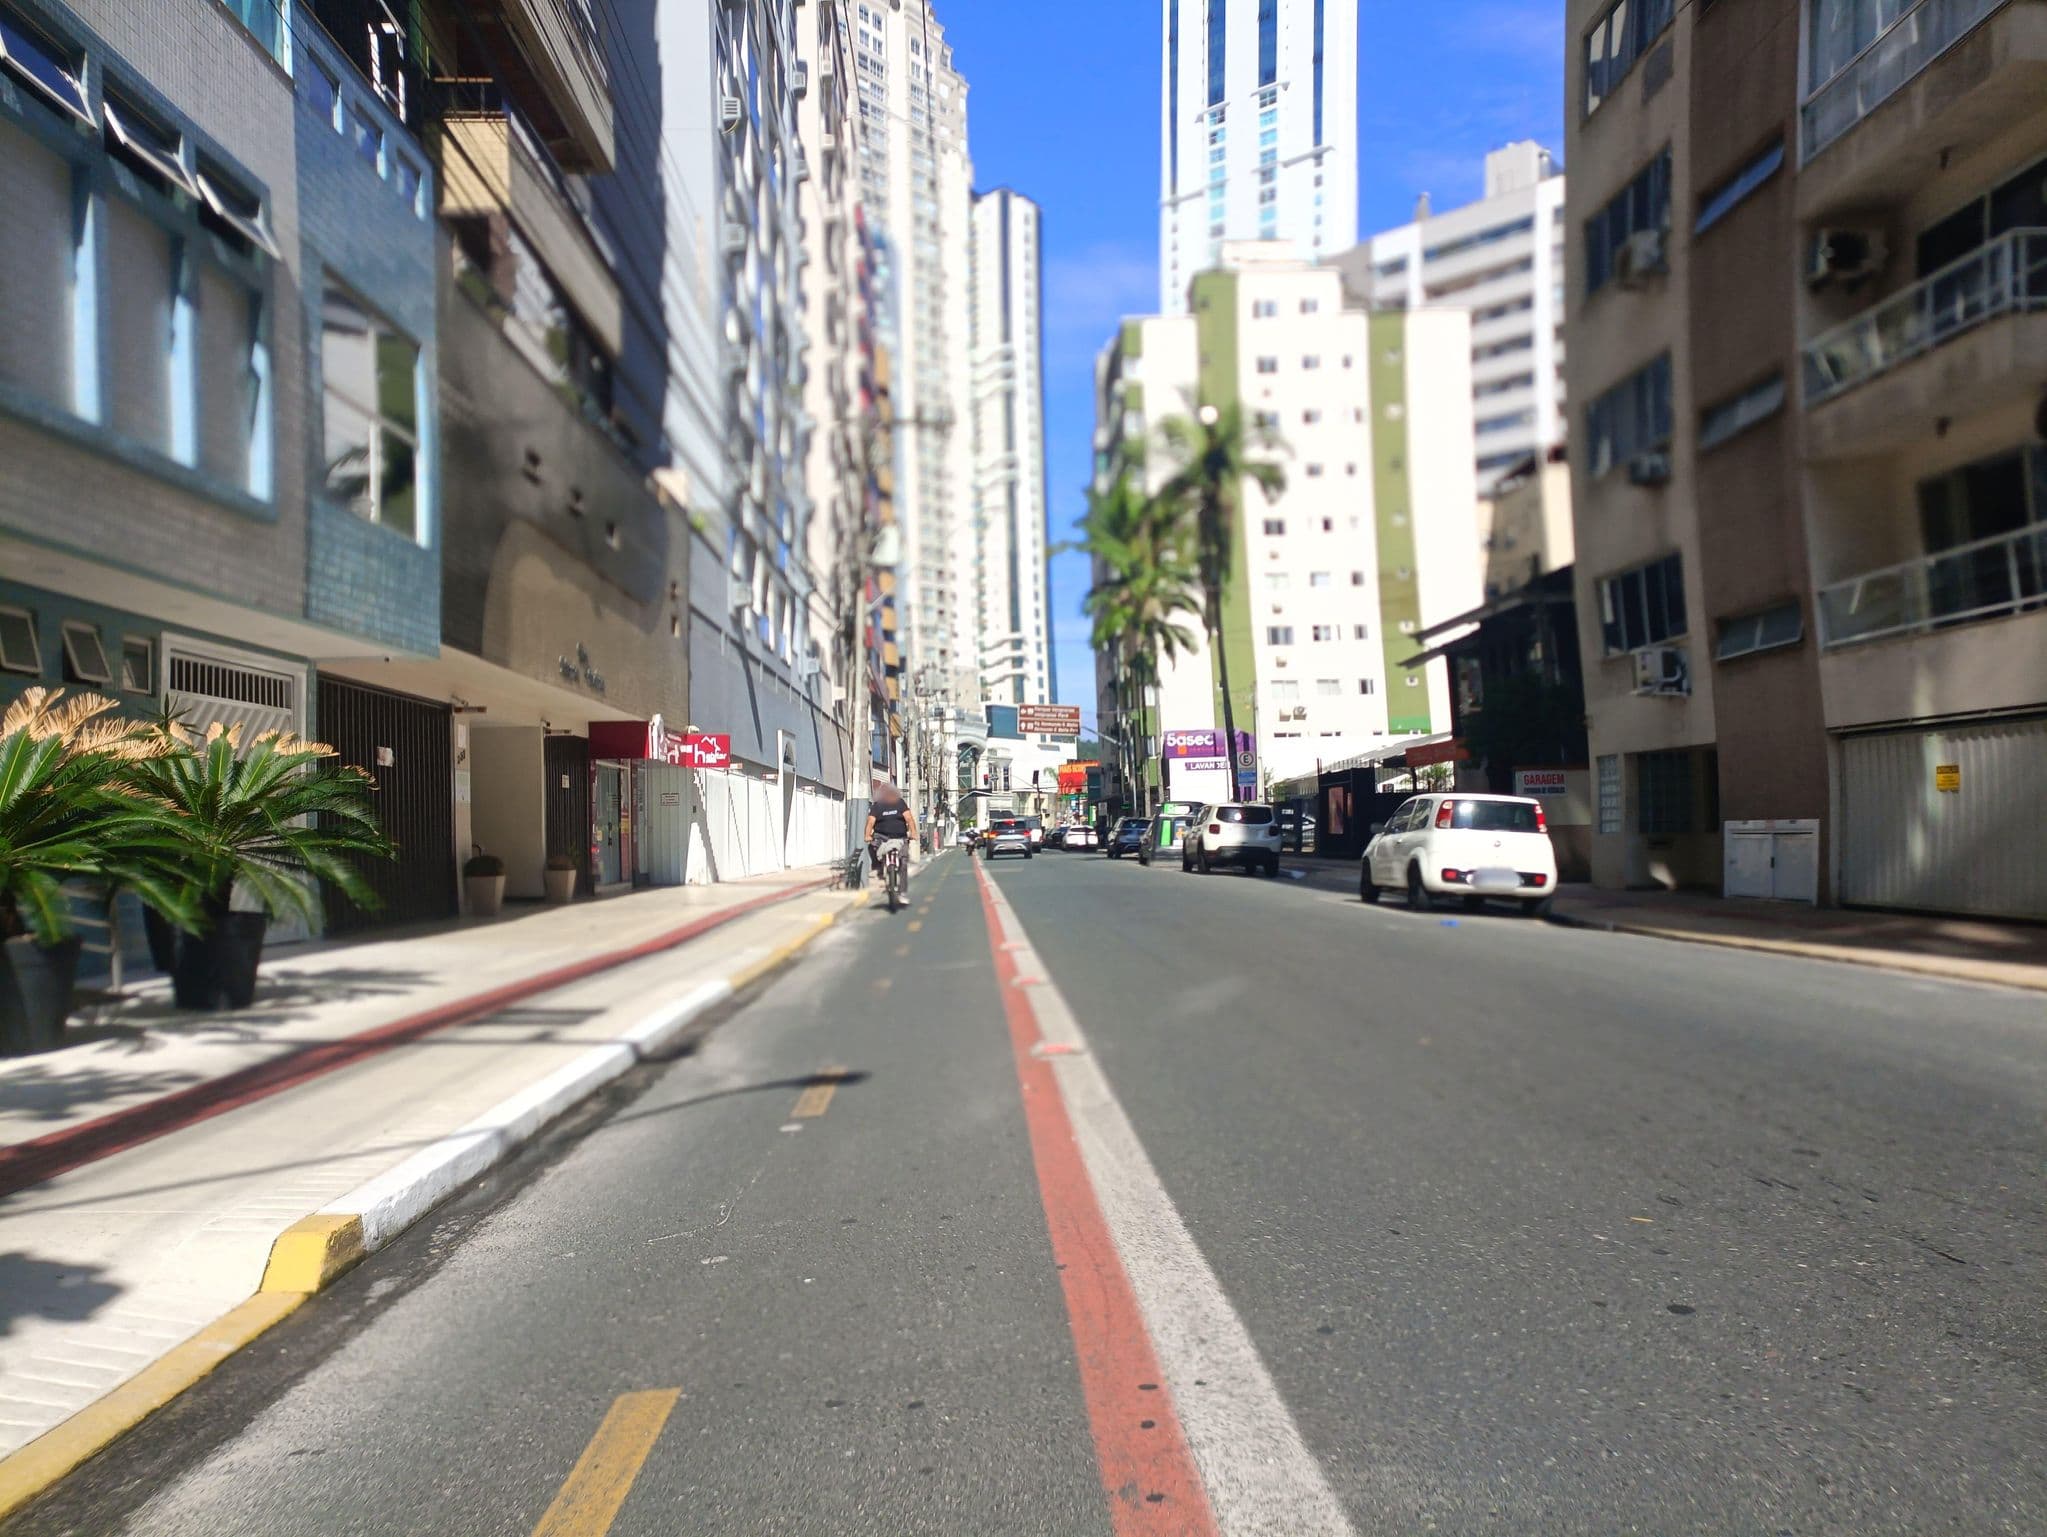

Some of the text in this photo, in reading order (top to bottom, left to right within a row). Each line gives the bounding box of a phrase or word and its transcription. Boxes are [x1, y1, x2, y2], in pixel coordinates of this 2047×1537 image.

[1166, 732, 1214, 747] 5asec
[1243, 754, 1249, 763] E
[1523, 773, 1565, 785] GARAGEM
